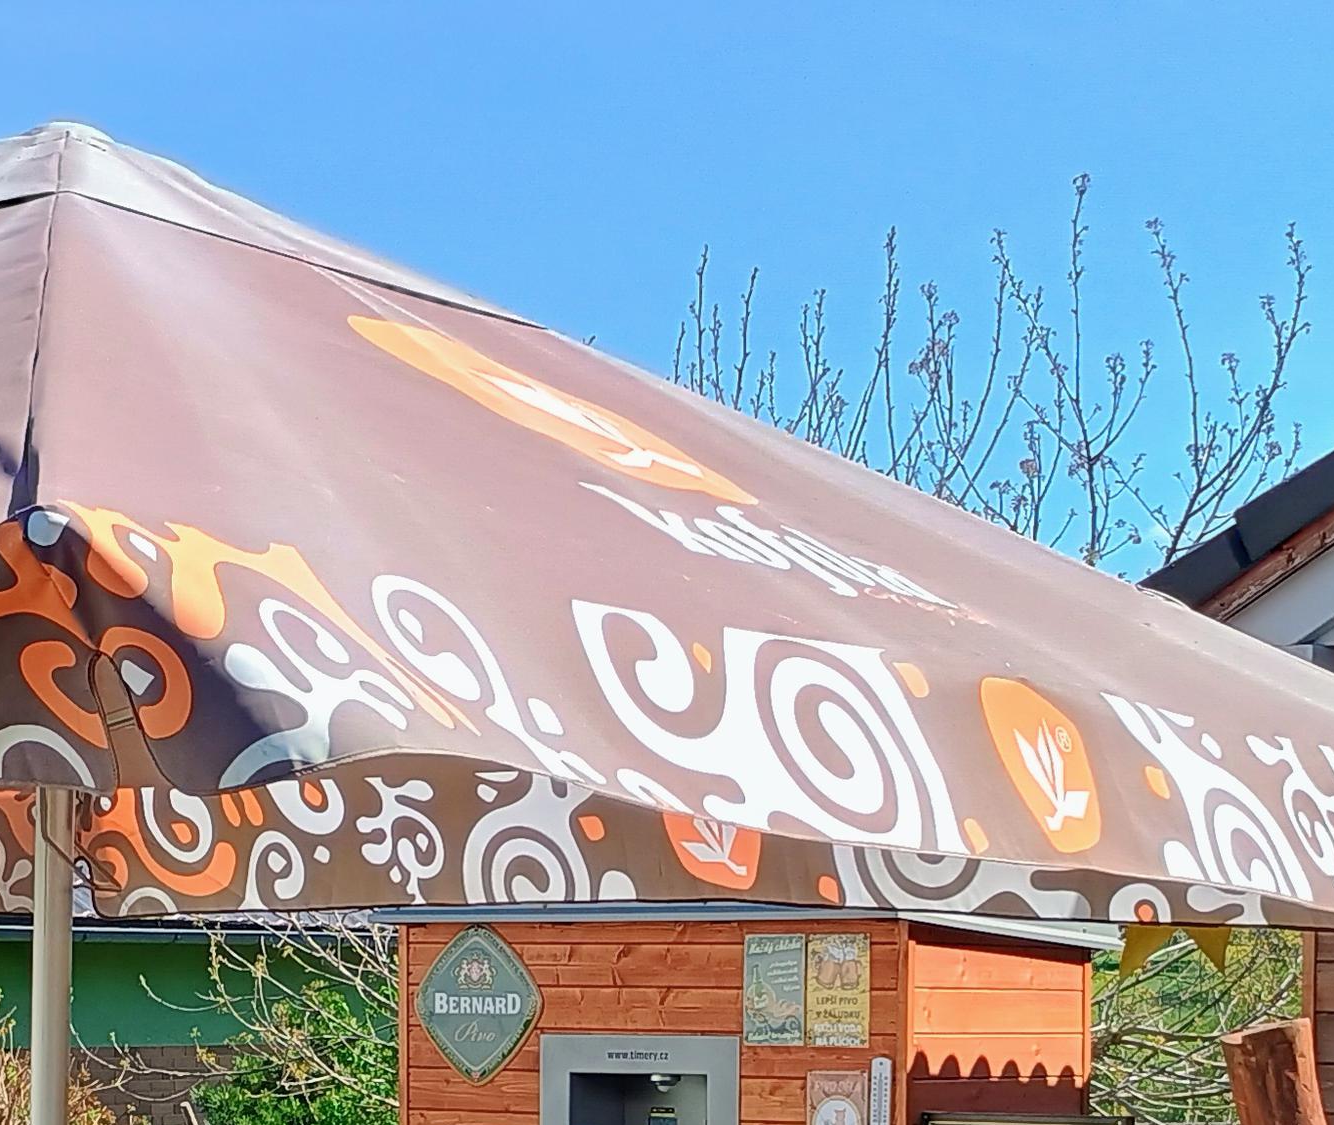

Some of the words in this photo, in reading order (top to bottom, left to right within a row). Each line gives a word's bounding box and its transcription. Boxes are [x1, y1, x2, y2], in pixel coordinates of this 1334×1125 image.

[433, 992, 522, 1015] BERNARD
[838, 996, 859, 1006] PIVO
[454, 1018, 497, 1042] Pivo
